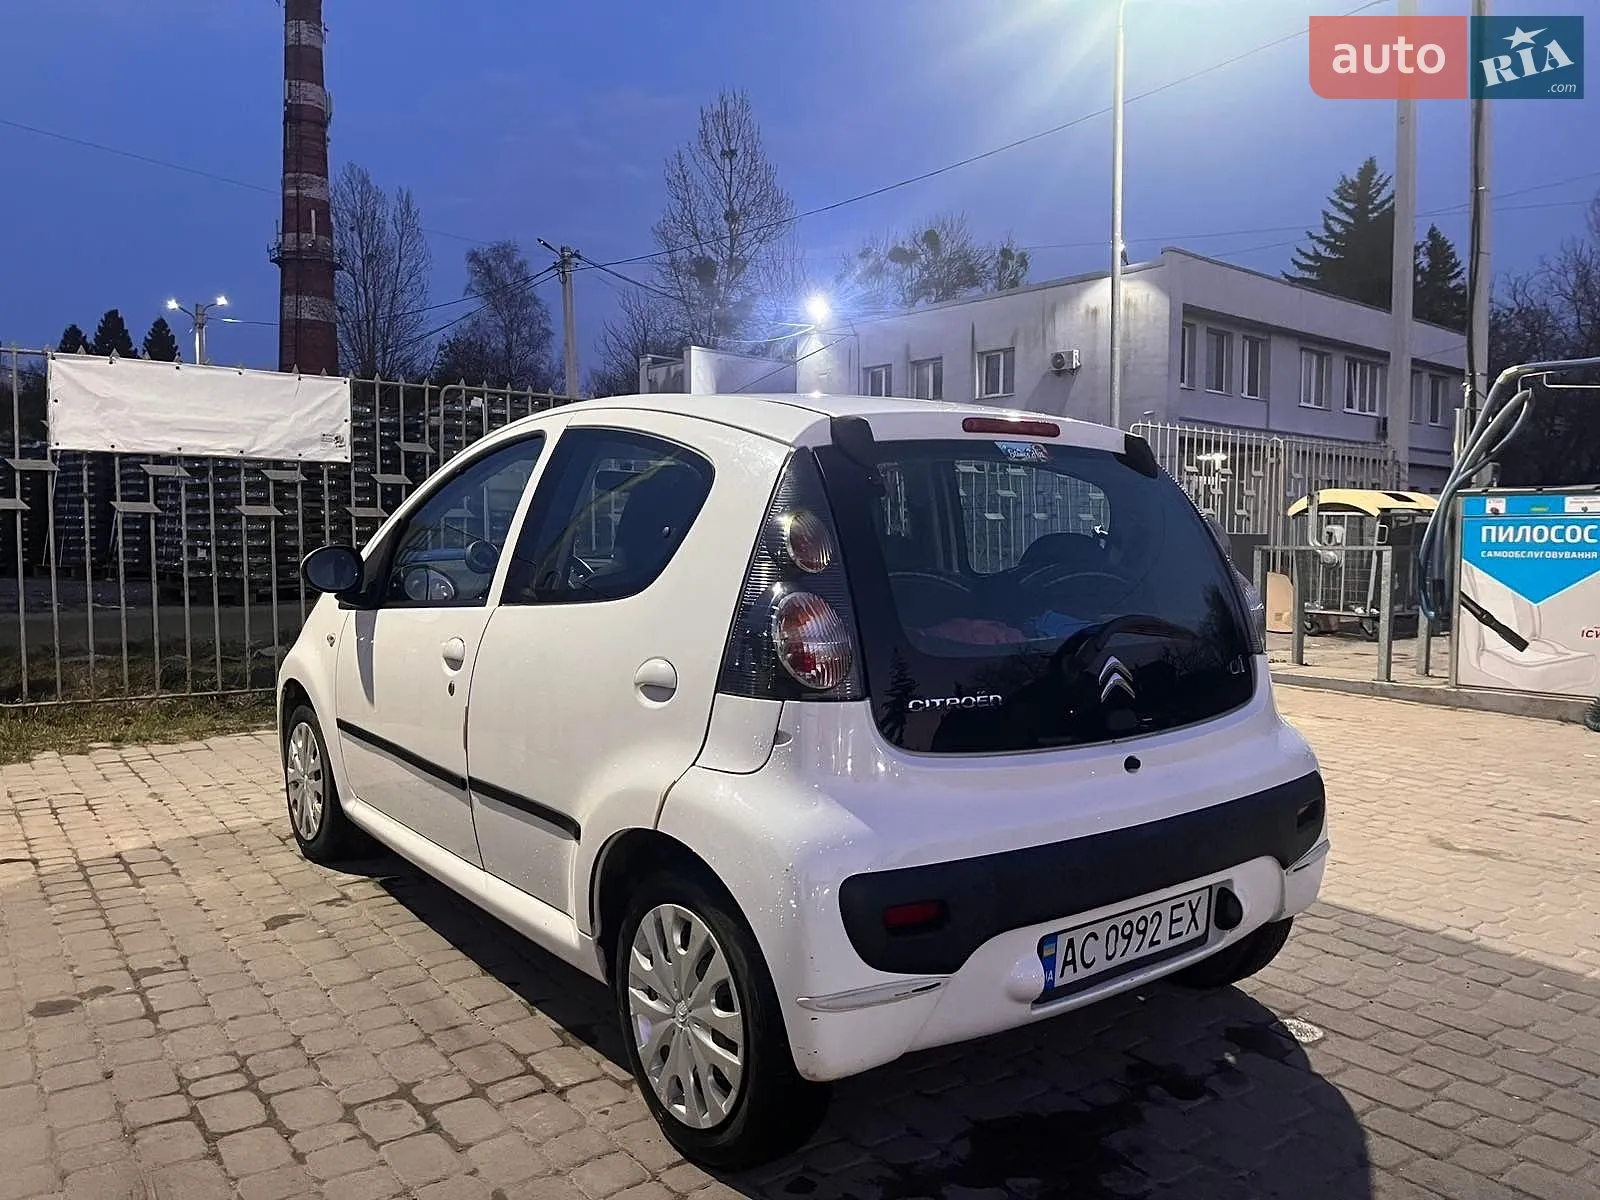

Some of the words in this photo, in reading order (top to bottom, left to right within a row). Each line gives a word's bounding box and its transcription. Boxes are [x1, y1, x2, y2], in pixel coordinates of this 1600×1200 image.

[1480, 524, 1599, 544] ПИЛОСОС
[1480, 550, 1598, 560] САМООБСЛУГОВУВАННЯ
[907, 690, 1003, 712] CITROËN
[1059, 932, 1099, 978] AC
[1105, 910, 1163, 961] 0992
[1168, 895, 1202, 940] EX
